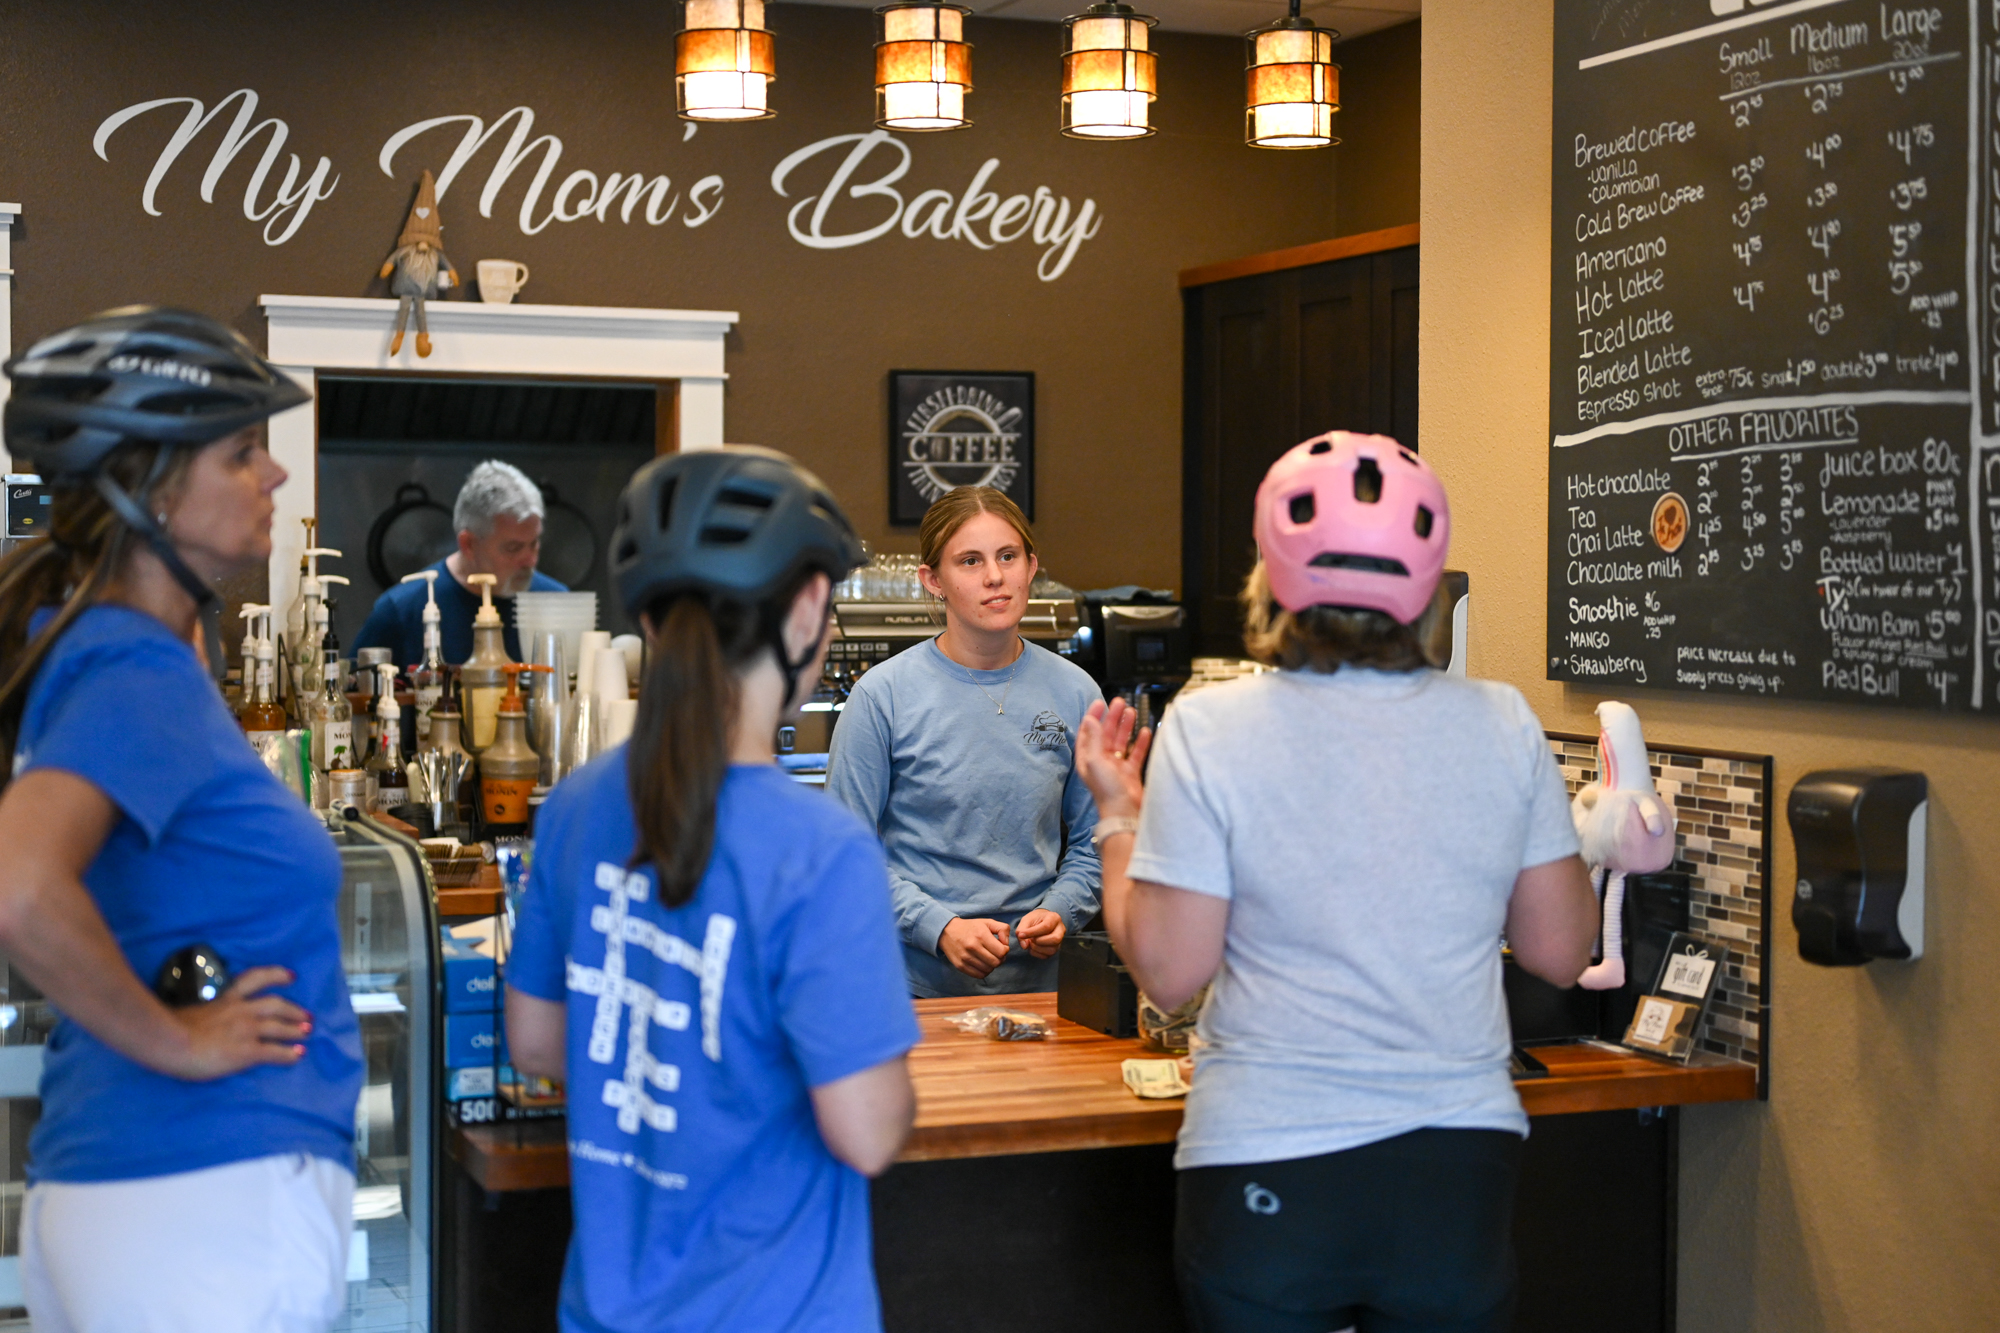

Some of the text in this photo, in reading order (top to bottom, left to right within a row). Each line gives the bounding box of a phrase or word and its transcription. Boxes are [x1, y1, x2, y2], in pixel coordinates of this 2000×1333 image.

[1719, 38, 1773, 73] Small
[1790, 21, 1868, 54] Medium
[1880, 2, 1942, 41] Large
[1575, 126, 1635, 168] Brewed
[92, 88, 1104, 283] My Mom's Bakery
[1575, 209, 1612, 242] Cold
[1617, 200, 1657, 230] Brew
[1575, 236, 1667, 282] Americano
[1576, 281, 1613, 324] Hot
[1578, 318, 1626, 359] Iced
[1577, 354, 1640, 395] Blended
[1669, 405, 1859, 452] OTHER FAVORITES
[908, 435, 1017, 462] COFFEE
[1880, 445, 1919, 475] box
[1568, 473, 1596, 500] Hot
[1597, 468, 1671, 496] chocolate
[1568, 506, 1596, 529] Tea
[1567, 532, 1601, 557] Chai
[1567, 560, 1643, 585] Chocolate
[1820, 546, 1884, 574] Bottled
[1569, 595, 1639, 625] Smoothie
[1882, 610, 1921, 637] Bam
[1570, 631, 1610, 649] MANGO
[1023, 732, 1046, 746] My
[485, 787, 518, 797] MONIN
